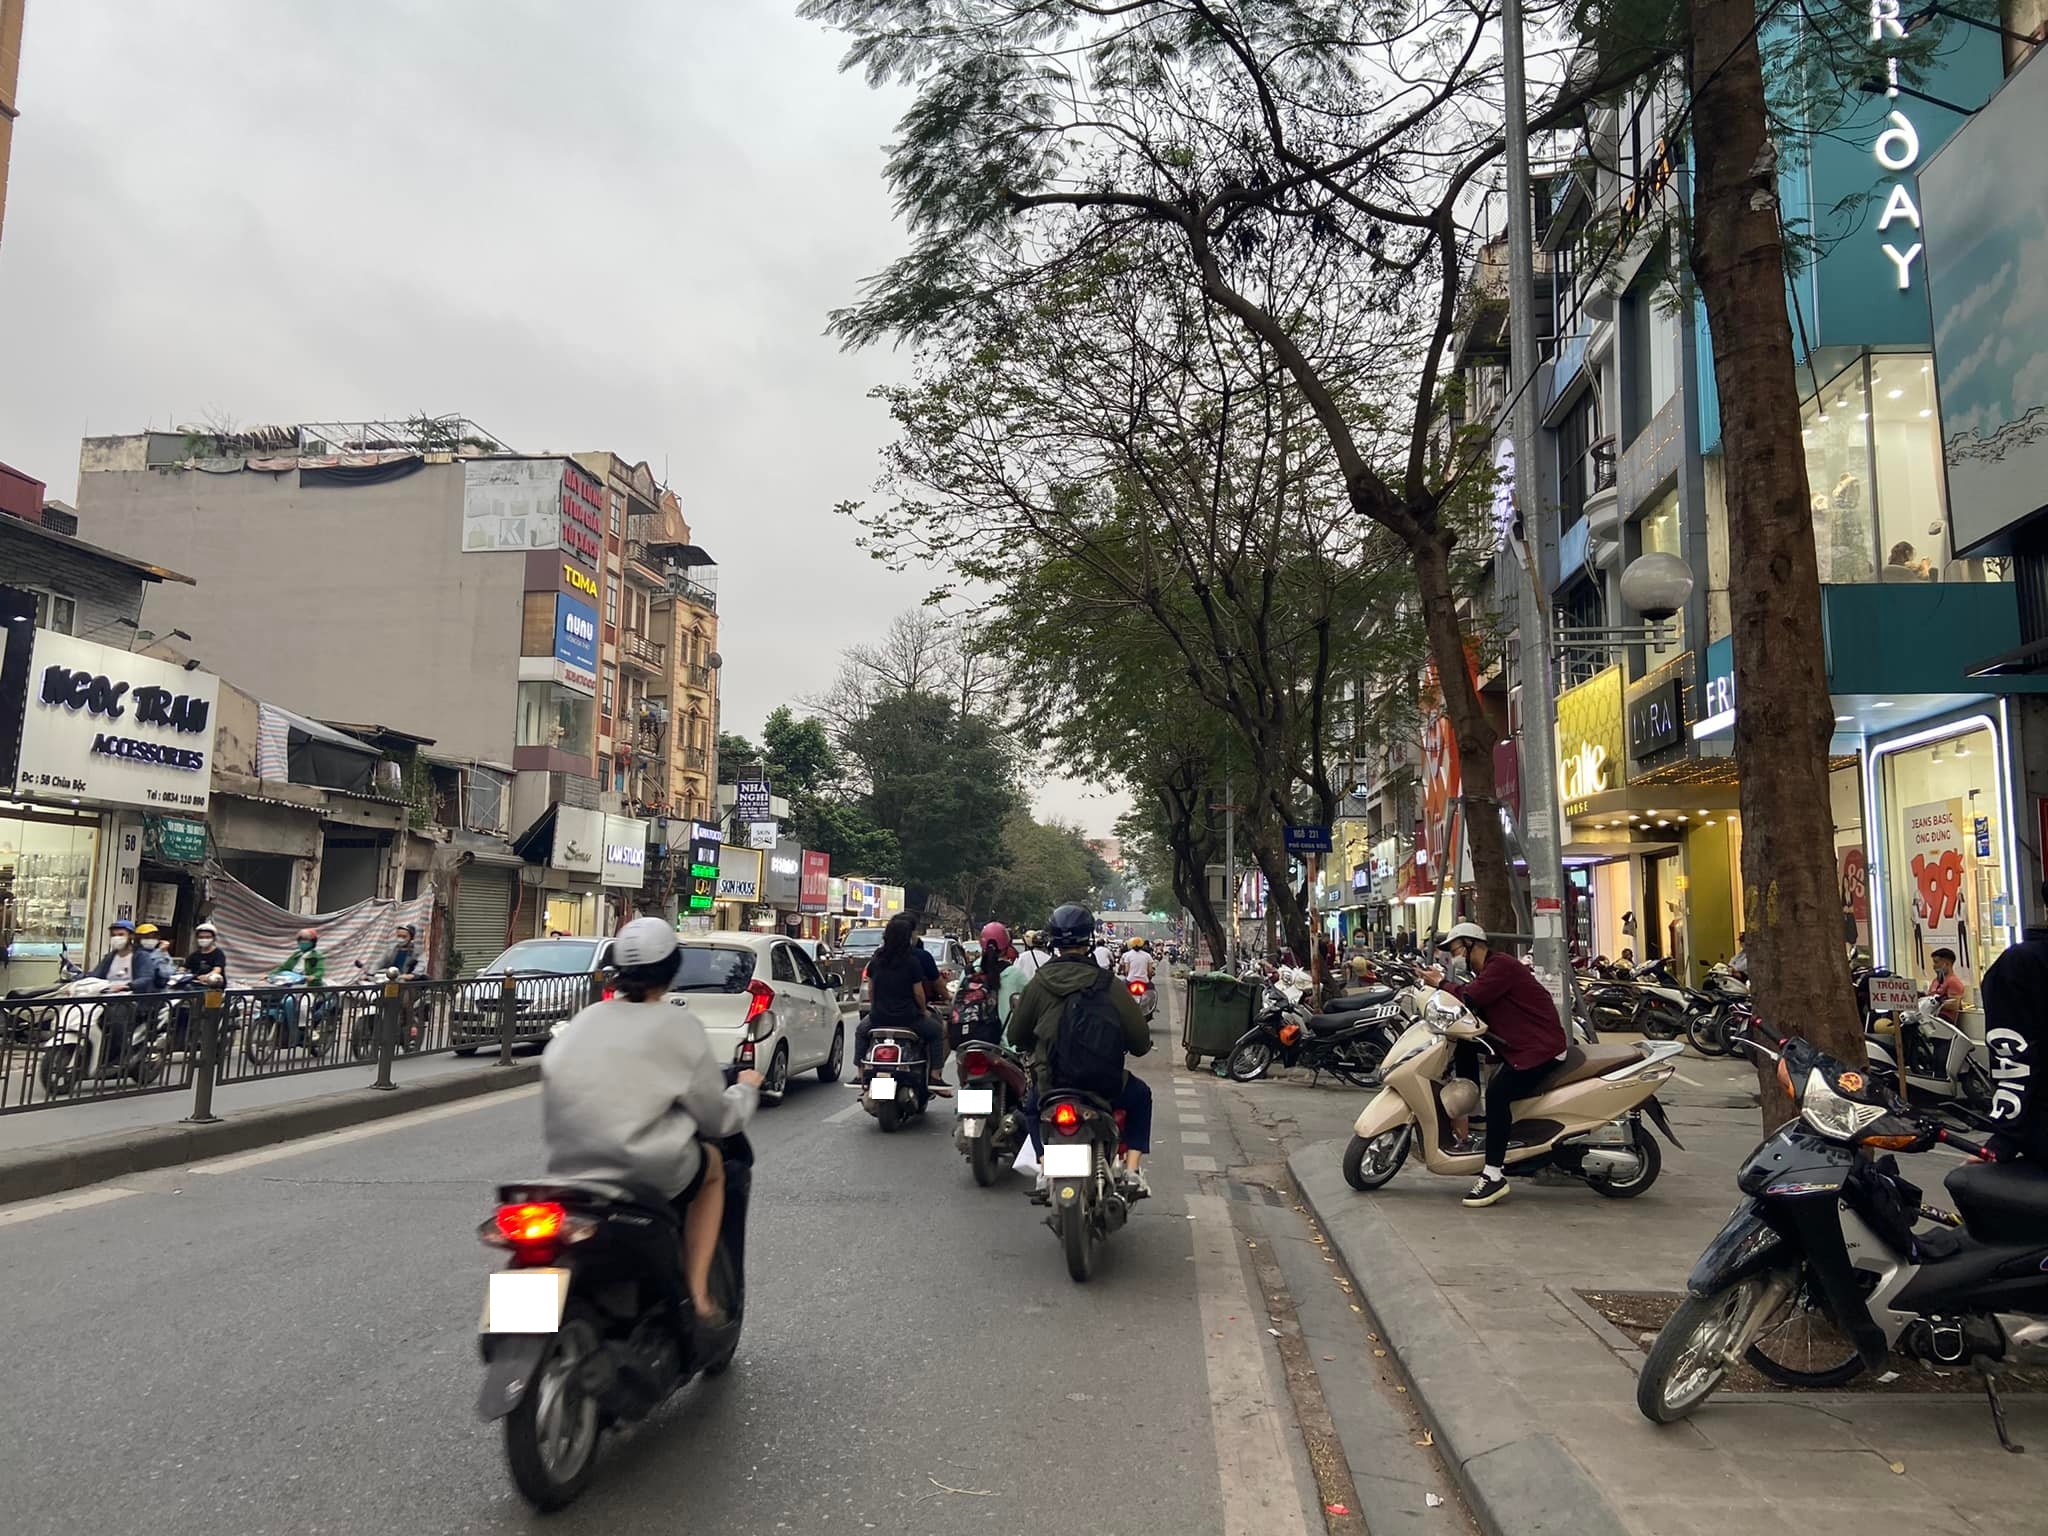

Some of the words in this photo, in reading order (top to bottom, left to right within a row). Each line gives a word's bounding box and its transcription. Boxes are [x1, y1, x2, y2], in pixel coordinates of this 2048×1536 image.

[563, 564, 599, 600] TOMA
[1633, 699, 1672, 745] LYRA
[91, 733, 205, 771] ACCESSORIES
[40, 774, 51, 786] 58
[125, 834, 137, 851] 58
[121, 867, 135, 888] PHỤ
[1872, 992, 1888, 1002] XE
[1889, 991, 1917, 1004] MÁY
